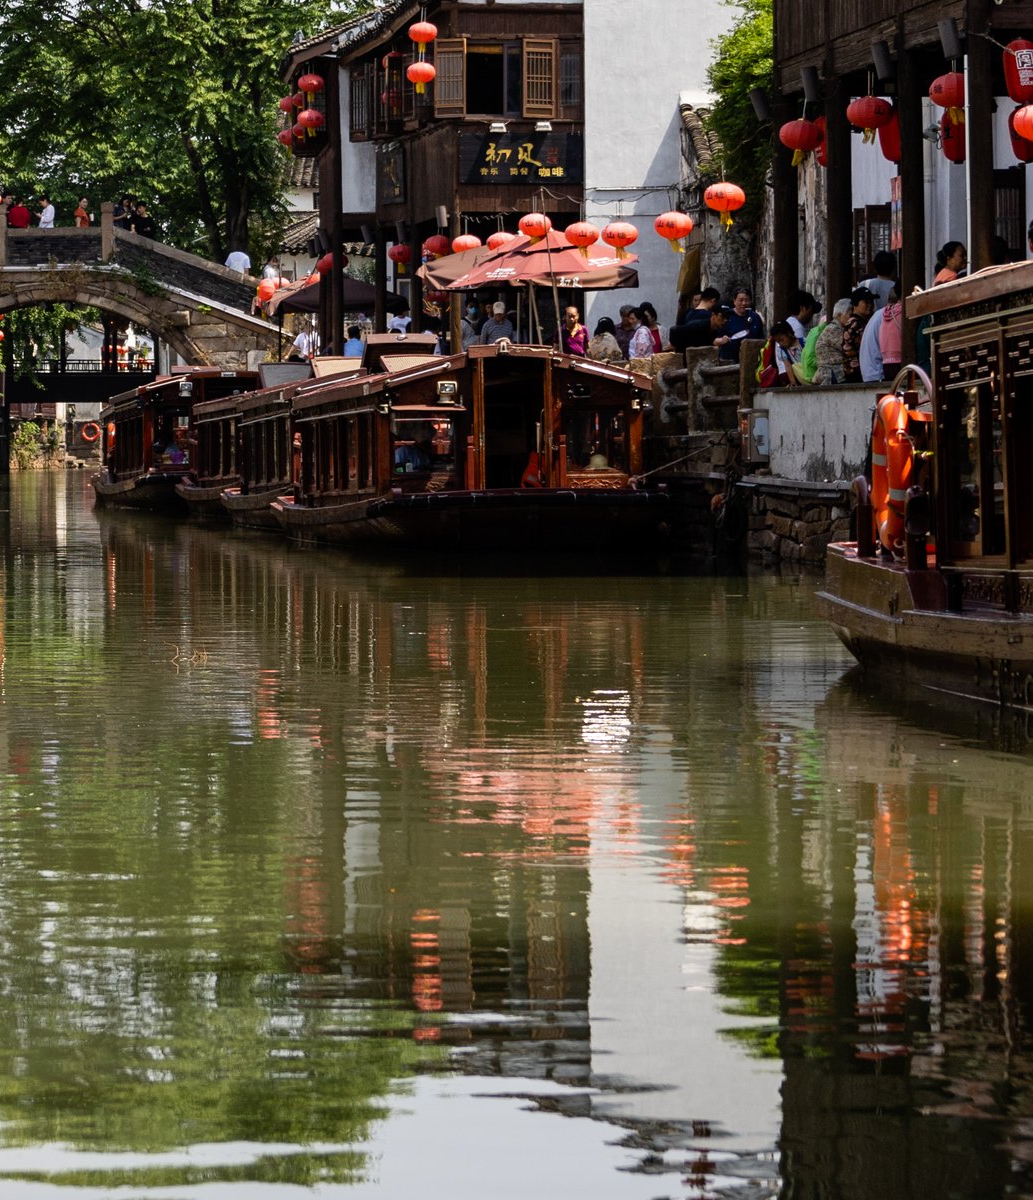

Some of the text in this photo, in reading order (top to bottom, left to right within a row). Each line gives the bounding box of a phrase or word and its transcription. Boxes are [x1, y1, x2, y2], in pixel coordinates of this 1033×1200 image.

[485, 142, 542, 167] 初见
[479, 167, 499, 176] 音乐
[538, 166, 564, 178] 咖啡
